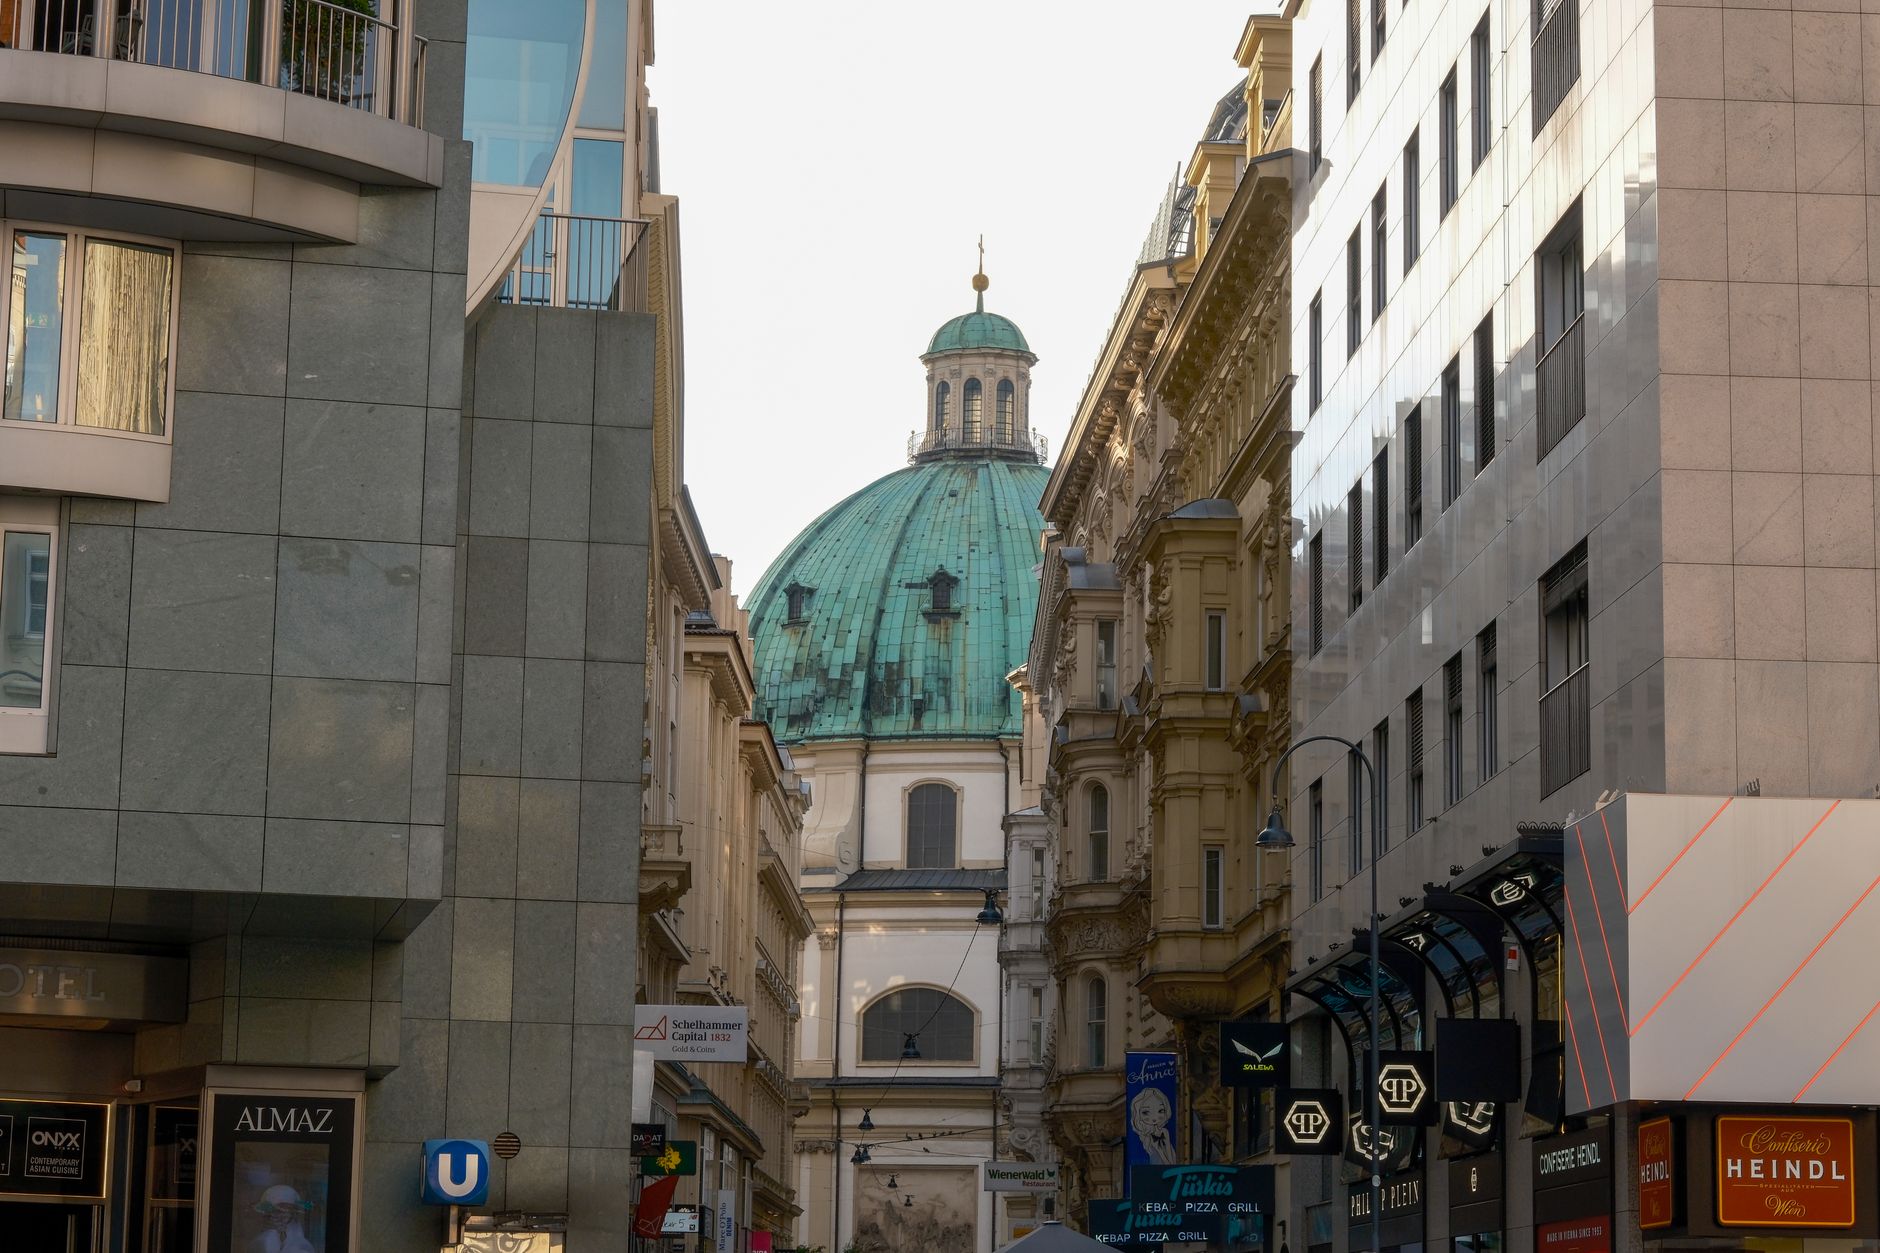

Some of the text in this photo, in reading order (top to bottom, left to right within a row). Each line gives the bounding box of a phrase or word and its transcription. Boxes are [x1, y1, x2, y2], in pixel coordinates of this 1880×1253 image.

[672, 1019, 743, 1030] Schelhammer
[671, 1031, 732, 1043] Capital 1832
[671, 1045, 689, 1053] Gold
[696, 1045, 716, 1053] Coins
[1126, 1058, 1176, 1085] Anna
[1242, 1063, 1275, 1071] SALEWA
[234, 1107, 334, 1133] ALMAZ
[31, 1130, 81, 1148] ONYX
[1740, 1124, 1831, 1155] Confiserie
[30, 1156, 80, 1167] CONTEMPORARY
[1539, 1141, 1601, 1175] CONFISERIE HEINDL
[29, 1165, 79, 1175] ASIAN CUISINE
[438, 1153, 479, 1197] U
[988, 1169, 1045, 1180] Wienerwald
[1640, 1159, 1669, 1184] HEINDL
[1727, 1158, 1846, 1181] HEINDL
[1161, 1165, 1240, 1202] Türkis
[1138, 1202, 1261, 1213] KEBAP PIZZA GRILL
[1351, 1180, 1419, 1217] PHILP PLEIN
[1765, 1194, 1806, 1218] Wien
[1095, 1231, 1209, 1243] KEBAP PIZZA GRILL
